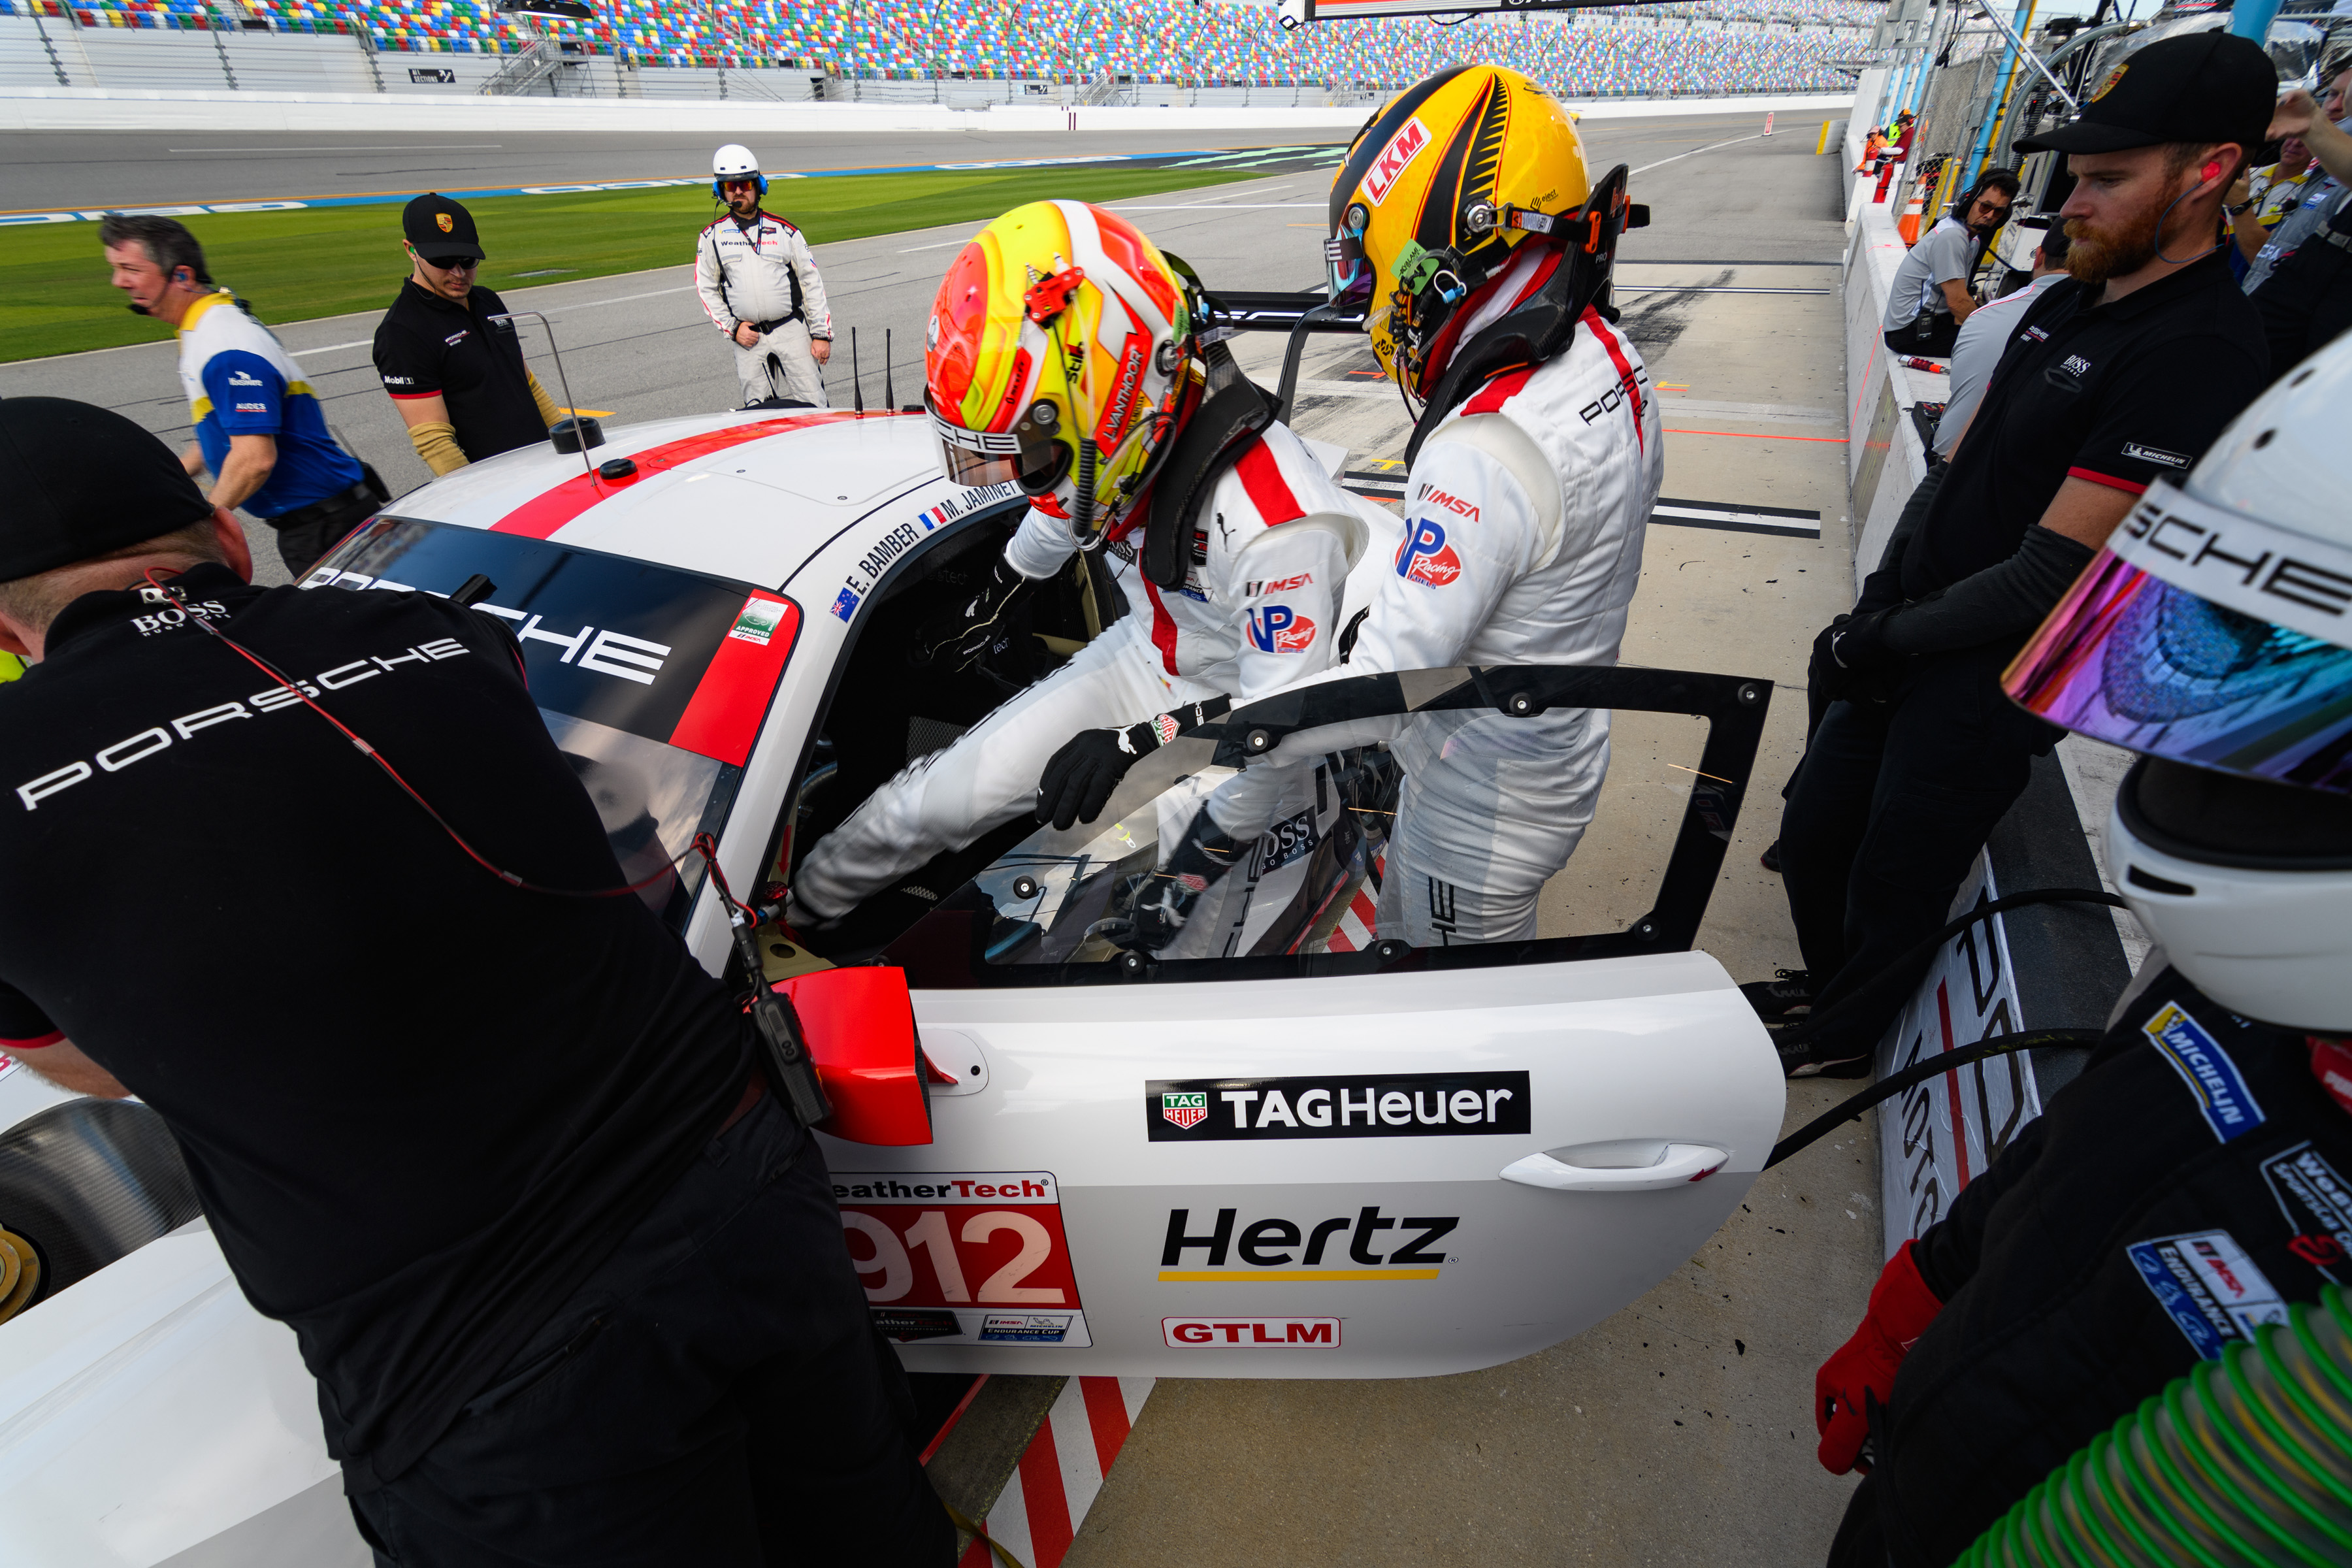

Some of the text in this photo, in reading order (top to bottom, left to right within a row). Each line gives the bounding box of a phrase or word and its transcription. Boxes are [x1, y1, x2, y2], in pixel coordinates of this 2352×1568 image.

[1367, 123, 1423, 201] LKM
[1542, 189, 1556, 202] eject
[2063, 355, 2091, 373] BOSS
[384, 376, 404, 385] Mobil
[2142, 451, 2185, 464] MICHELIN
[940, 499, 964, 519] M.
[1427, 489, 1480, 523] IMSA
[845, 523, 920, 596] E. BAMBER
[1413, 557, 1461, 580] Racing
[1264, 573, 1313, 595] IMSA
[1409, 574, 1437, 589] FUELS
[131, 600, 226, 632] BOSS
[142, 623, 184, 637] HUGO
[736, 626, 770, 638] APPROVED
[1277, 628, 1316, 647] Racing
[16, 638, 470, 811] PORSCHE
[1283, 838, 1314, 860] BOSS
[2168, 1030, 2244, 1125] MICHELIN
[1166, 1095, 1203, 1107] TAG
[1166, 1109, 1205, 1128] HEUER
[832, 1179, 1046, 1198] eatherTech
[840, 1211, 1066, 1304] 912
[2158, 1246, 2236, 1337] ENDURANCE
[1173, 1324, 1331, 1344] GTLM
